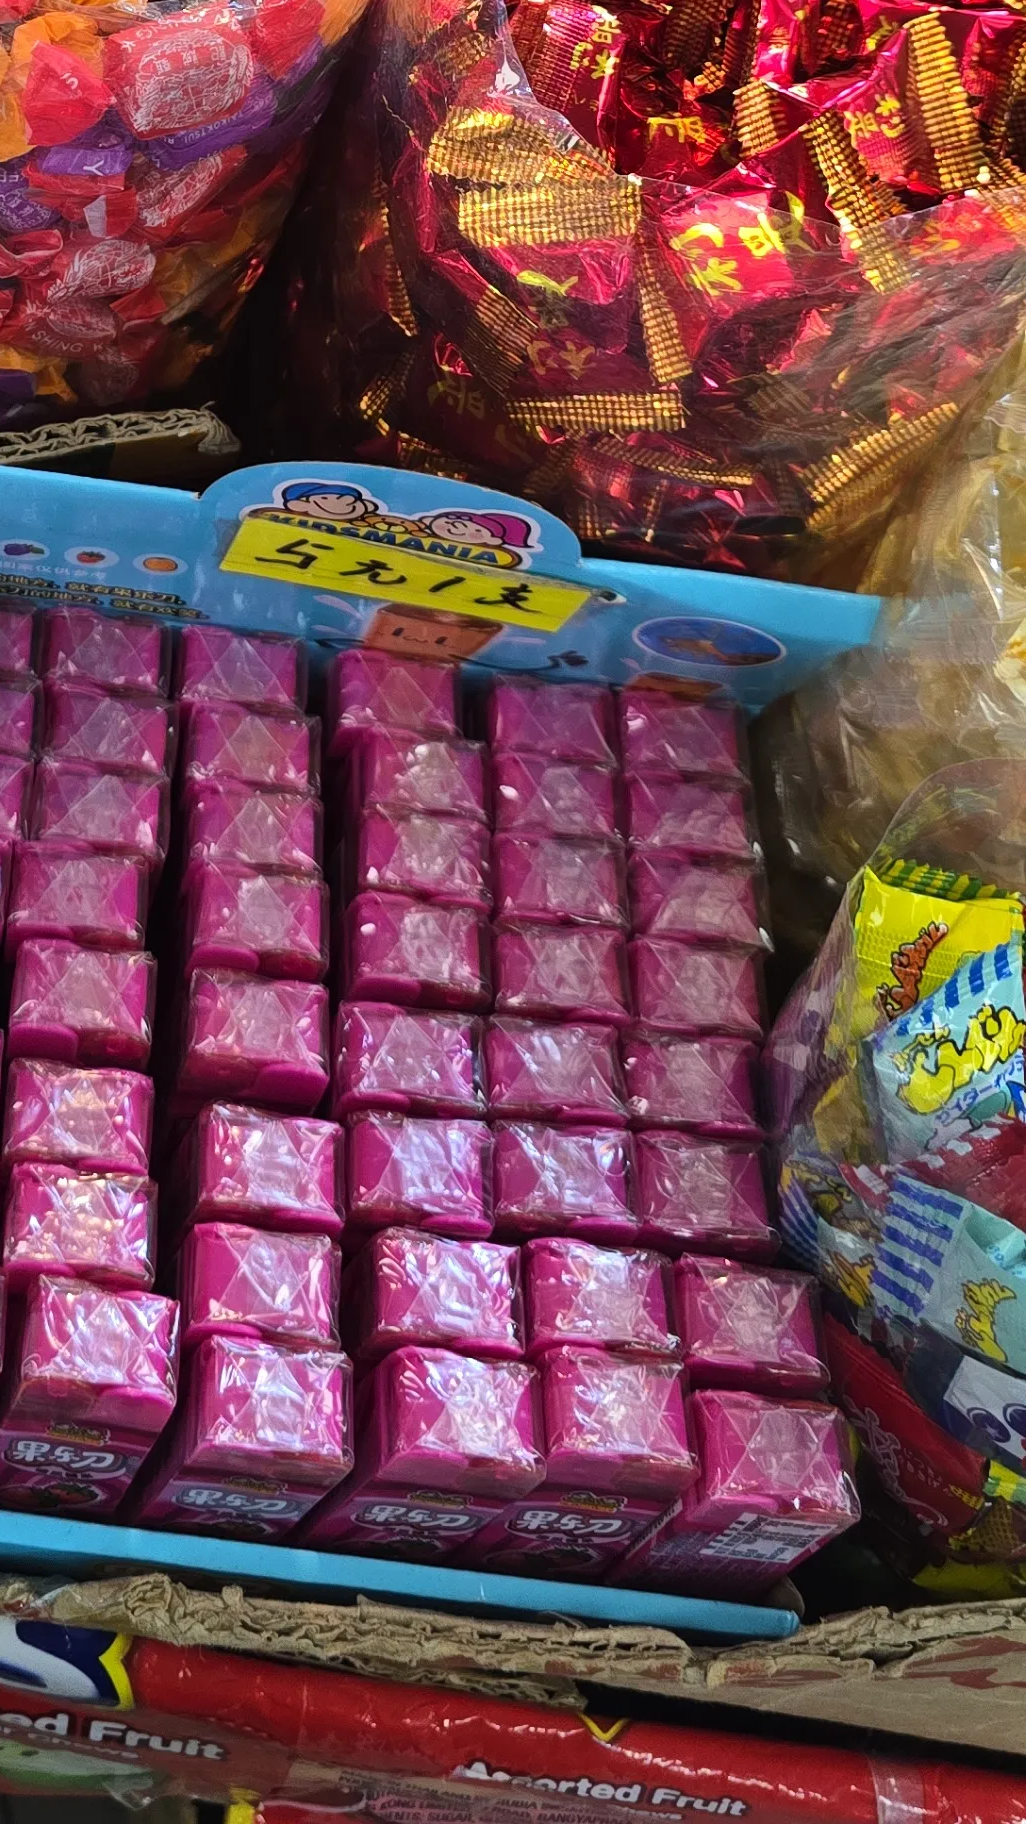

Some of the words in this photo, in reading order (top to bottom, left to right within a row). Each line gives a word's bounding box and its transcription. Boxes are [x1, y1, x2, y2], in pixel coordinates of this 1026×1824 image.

[32, 329, 84, 353] SHING
[15, 1438, 118, 1469] 果乐刀
[186, 1485, 291, 1515] 果乐刀
[368, 1503, 473, 1531] 果乐刀
[522, 1508, 625, 1536] 果乐刀
[88, 1718, 227, 1762] Fruit
[651, 1787, 748, 1818] Fruit
